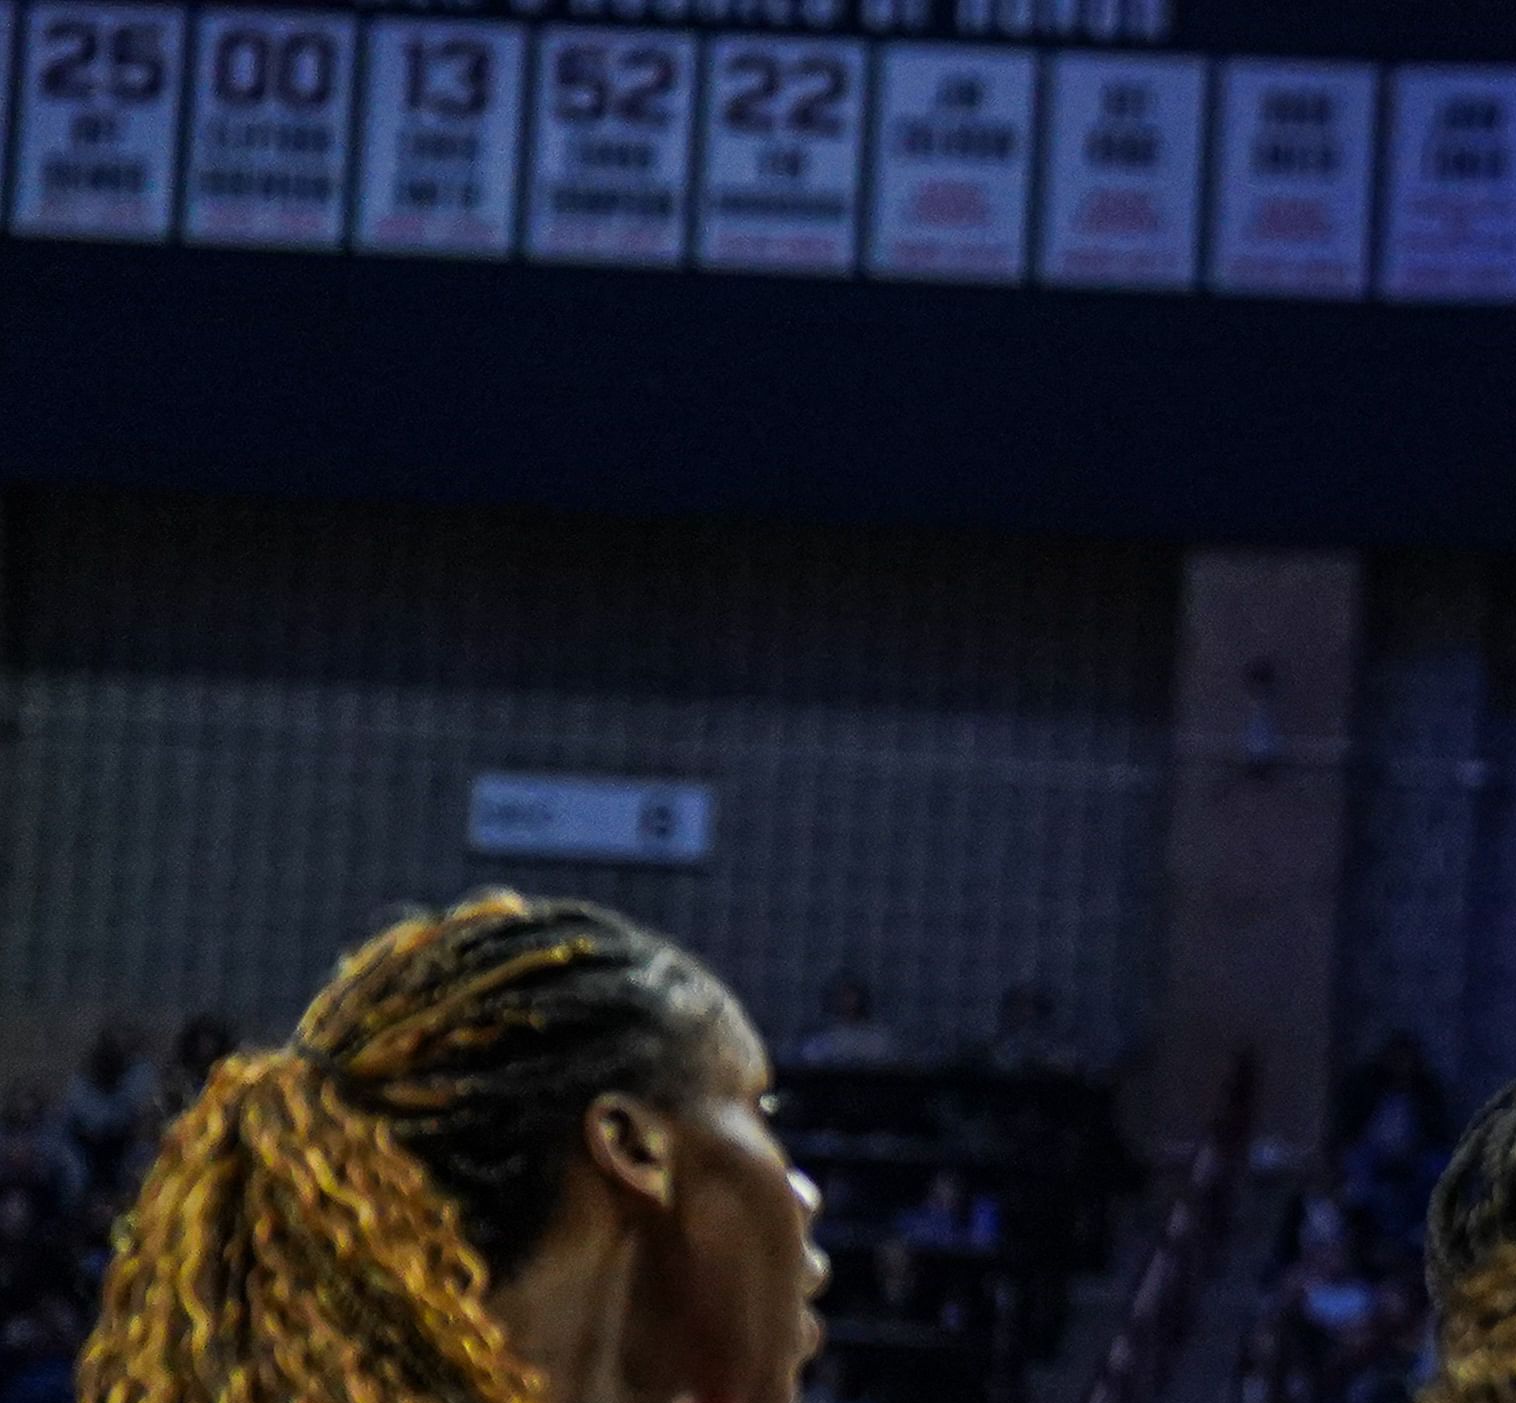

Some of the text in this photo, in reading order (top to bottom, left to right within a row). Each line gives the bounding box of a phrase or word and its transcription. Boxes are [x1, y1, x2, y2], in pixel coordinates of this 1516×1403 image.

[41, 18, 164, 101] 25
[213, 28, 336, 107] 00
[405, 39, 493, 117] 13
[552, 44, 678, 126] 52
[723, 51, 849, 136] 22
